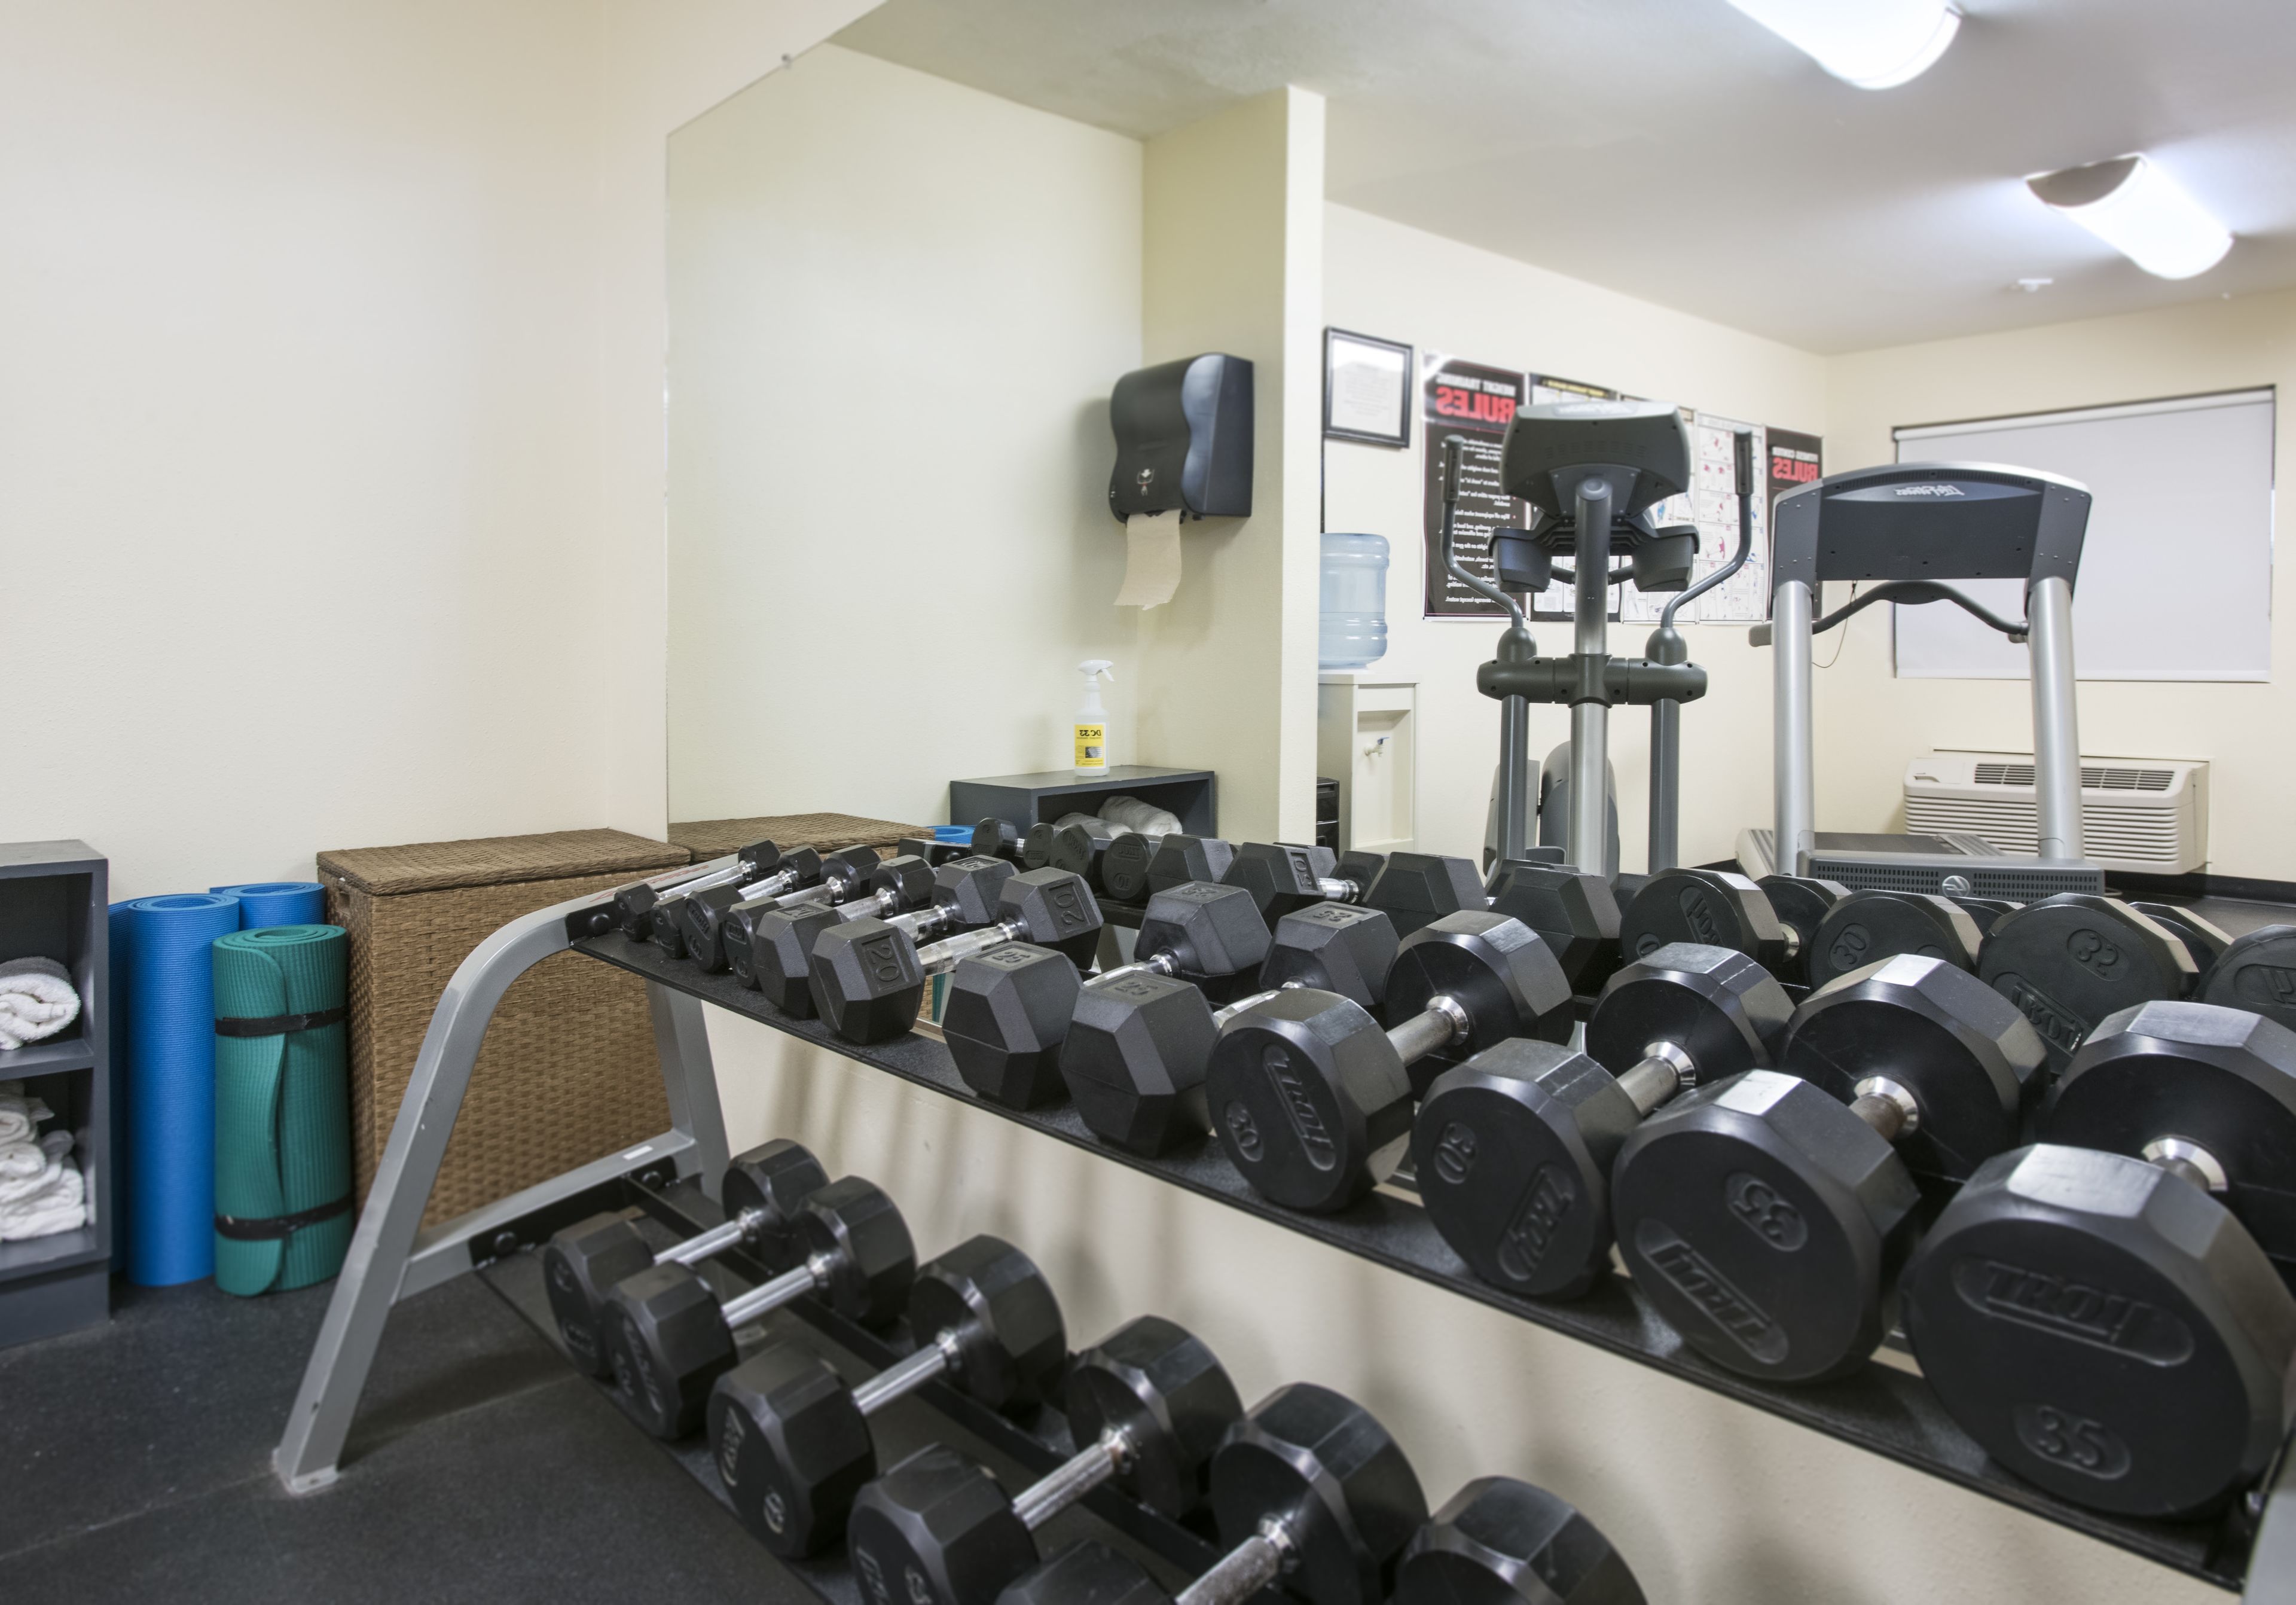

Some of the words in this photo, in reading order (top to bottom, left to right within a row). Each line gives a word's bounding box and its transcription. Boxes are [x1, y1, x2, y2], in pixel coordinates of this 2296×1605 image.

[865, 943, 900, 982] 20
[1227, 1107, 1261, 1149] 30
[1268, 1058, 1336, 1151] TROY
[1437, 1122, 1476, 1174] 30
[1508, 1169, 1575, 1271] TROY
[1730, 1182, 1799, 1240] 35
[1644, 1241, 1771, 1350] TROY
[1983, 1261, 2154, 1347] TROY
[2038, 1405, 2108, 1469] 35
